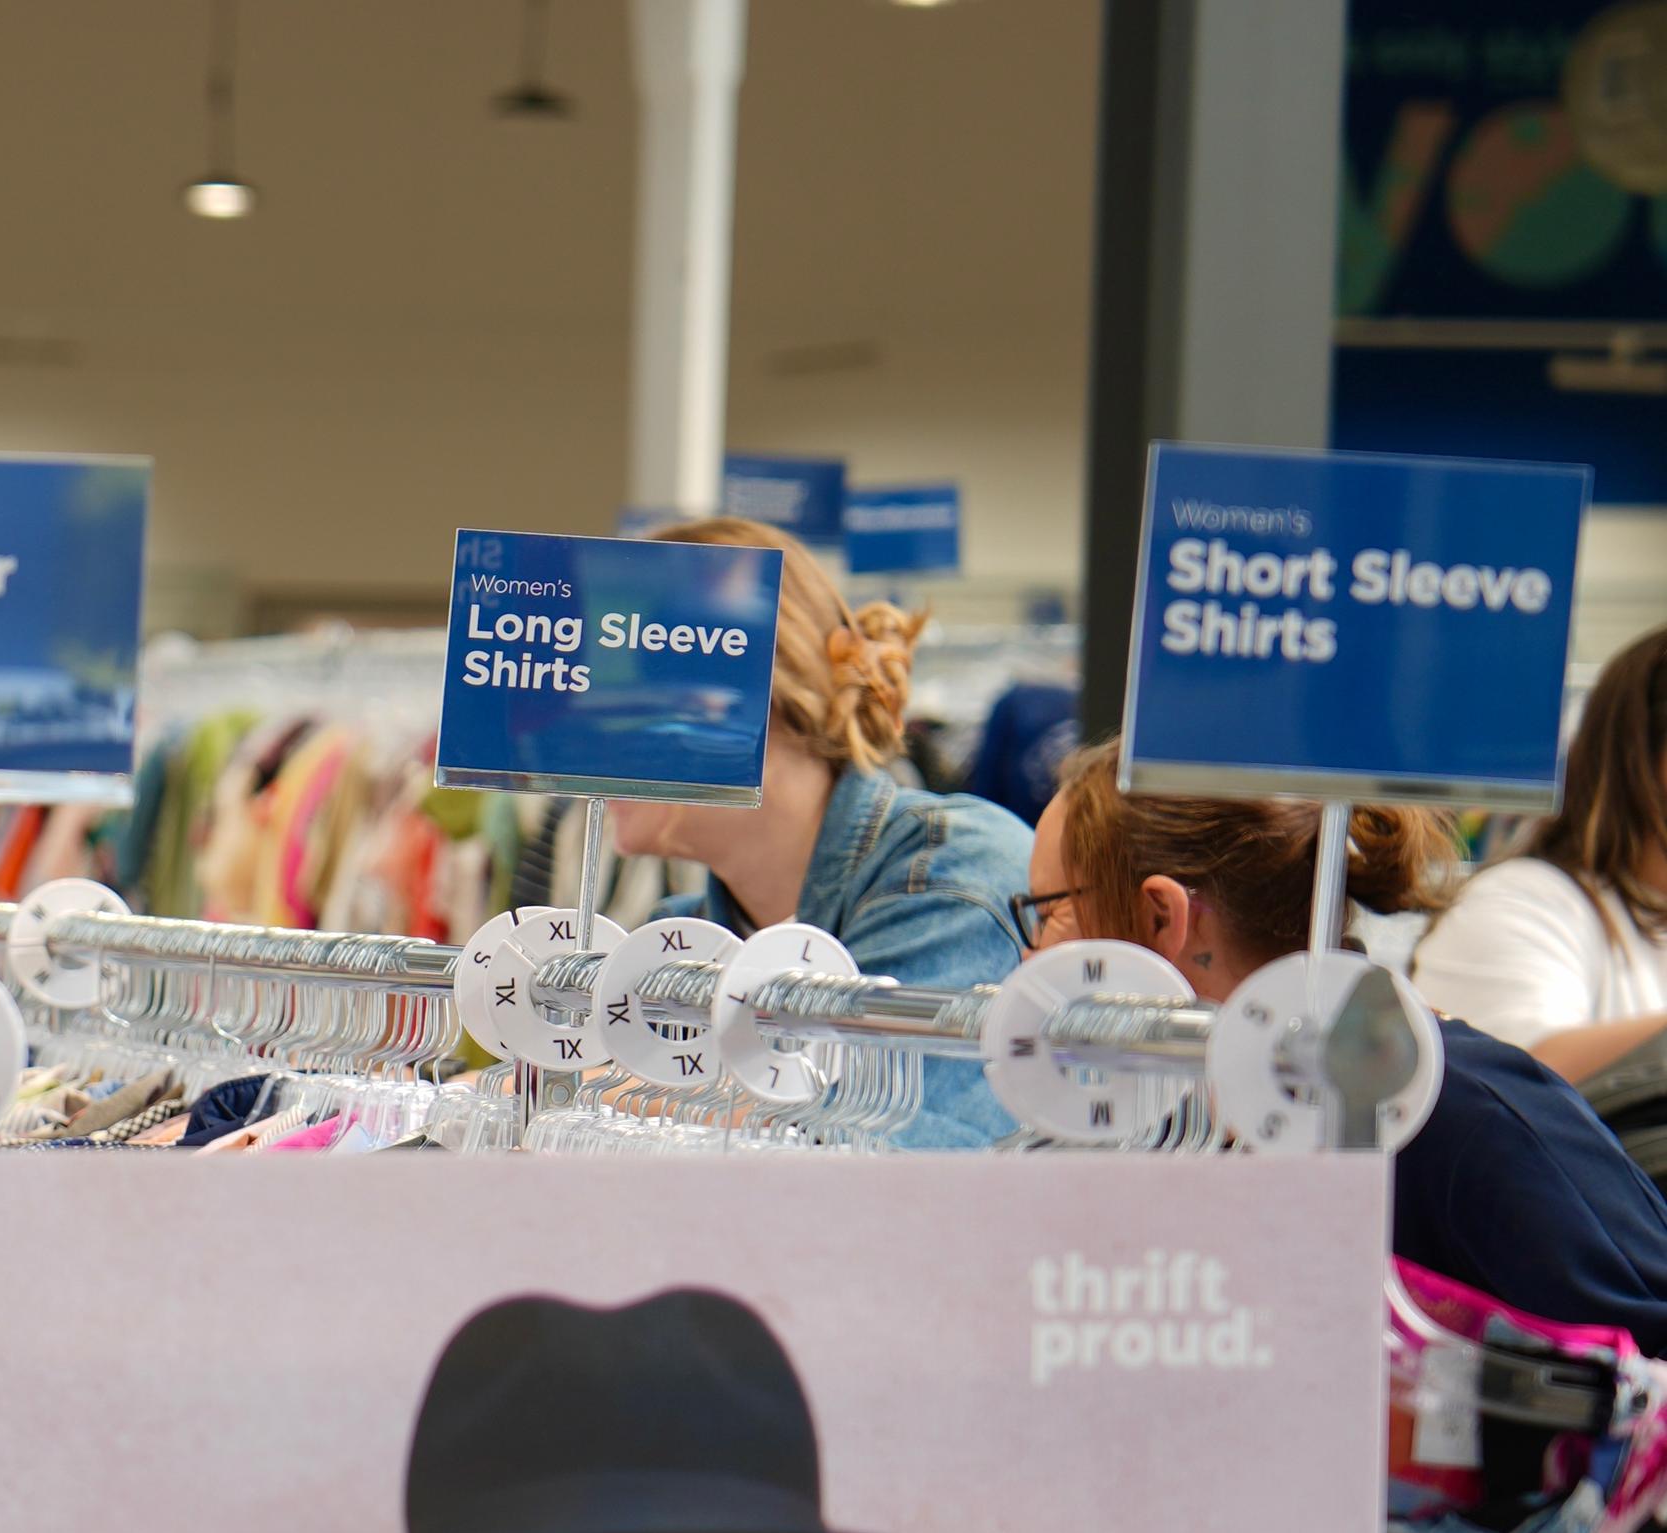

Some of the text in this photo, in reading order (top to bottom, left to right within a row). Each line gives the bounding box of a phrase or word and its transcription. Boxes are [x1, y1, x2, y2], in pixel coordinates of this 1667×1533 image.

[1172, 499, 1312, 537] Women's
[471, 573, 572, 598] Women's
[1167, 538, 1552, 615] Short Sleeve
[468, 604, 748, 656] Long Sleeve
[1161, 600, 1337, 662] Shirts
[462, 650, 591, 693] Shirts
[549, 921, 576, 941] XL
[660, 930, 692, 952] XL
[801, 940, 811, 963] L
[1084, 959, 1104, 983] M
[495, 977, 516, 1006] XL
[607, 994, 631, 1026] XL
[553, 1038, 583, 1060] XL
[1010, 1038, 1035, 1058] M
[672, 1052, 705, 1077] XL
[768, 1065, 780, 1089] L
[1091, 1101, 1113, 1127] M
[1031, 1250, 1229, 1314] thrift
[1032, 1307, 1273, 1387] proud.
